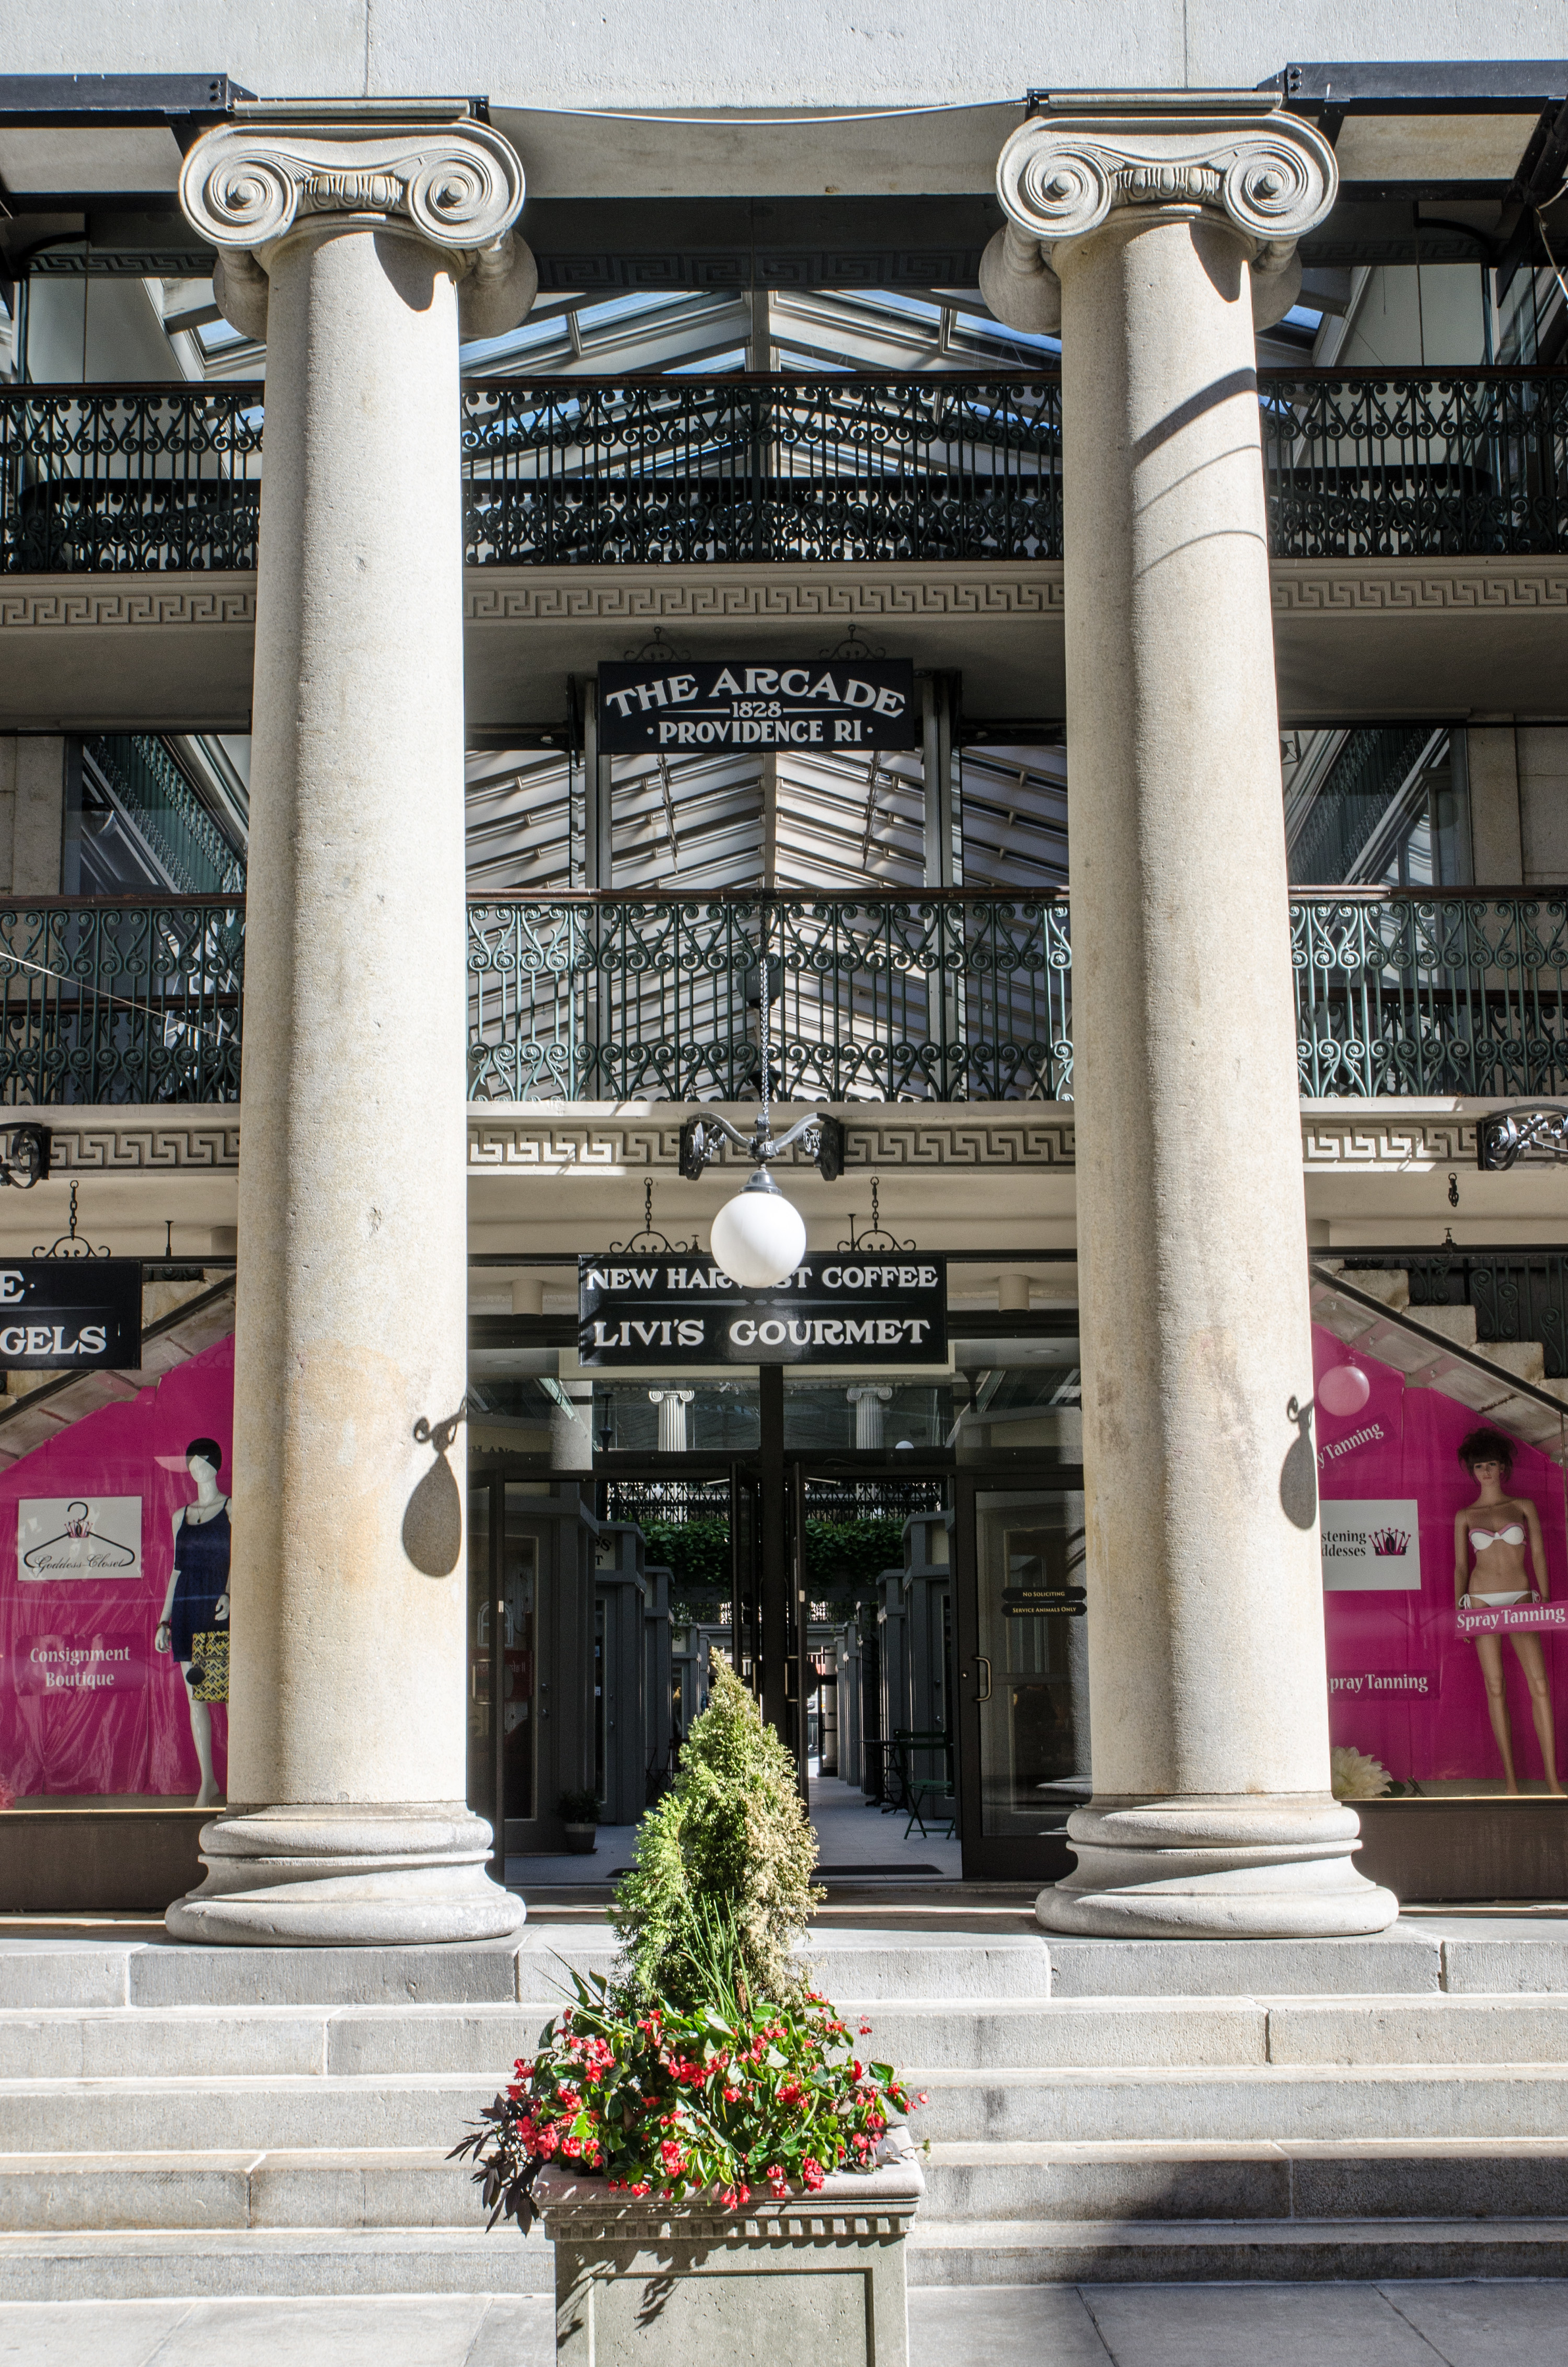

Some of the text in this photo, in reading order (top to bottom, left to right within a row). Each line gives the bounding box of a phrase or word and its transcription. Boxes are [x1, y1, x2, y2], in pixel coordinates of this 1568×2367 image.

[606, 668, 905, 718] THE ARCADE
[733, 701, 782, 718] 1828
[659, 720, 863, 744] PROVIDENCE RI
[586, 1266, 939, 1290] NEW HARST COFFEE
[0, 1326, 107, 1355] GELS
[594, 1319, 930, 1347] LIVI'S GOURMET
[1323, 1423, 1384, 1459] Tanning
[32, 1553, 125, 1578] Goddess Closet
[1457, 1607, 1566, 1631] Spray Tanning
[30, 1646, 131, 1666] Consignment
[46, 1671, 114, 1690] Boutique
[1327, 1673, 1428, 1693] pray Tanning
